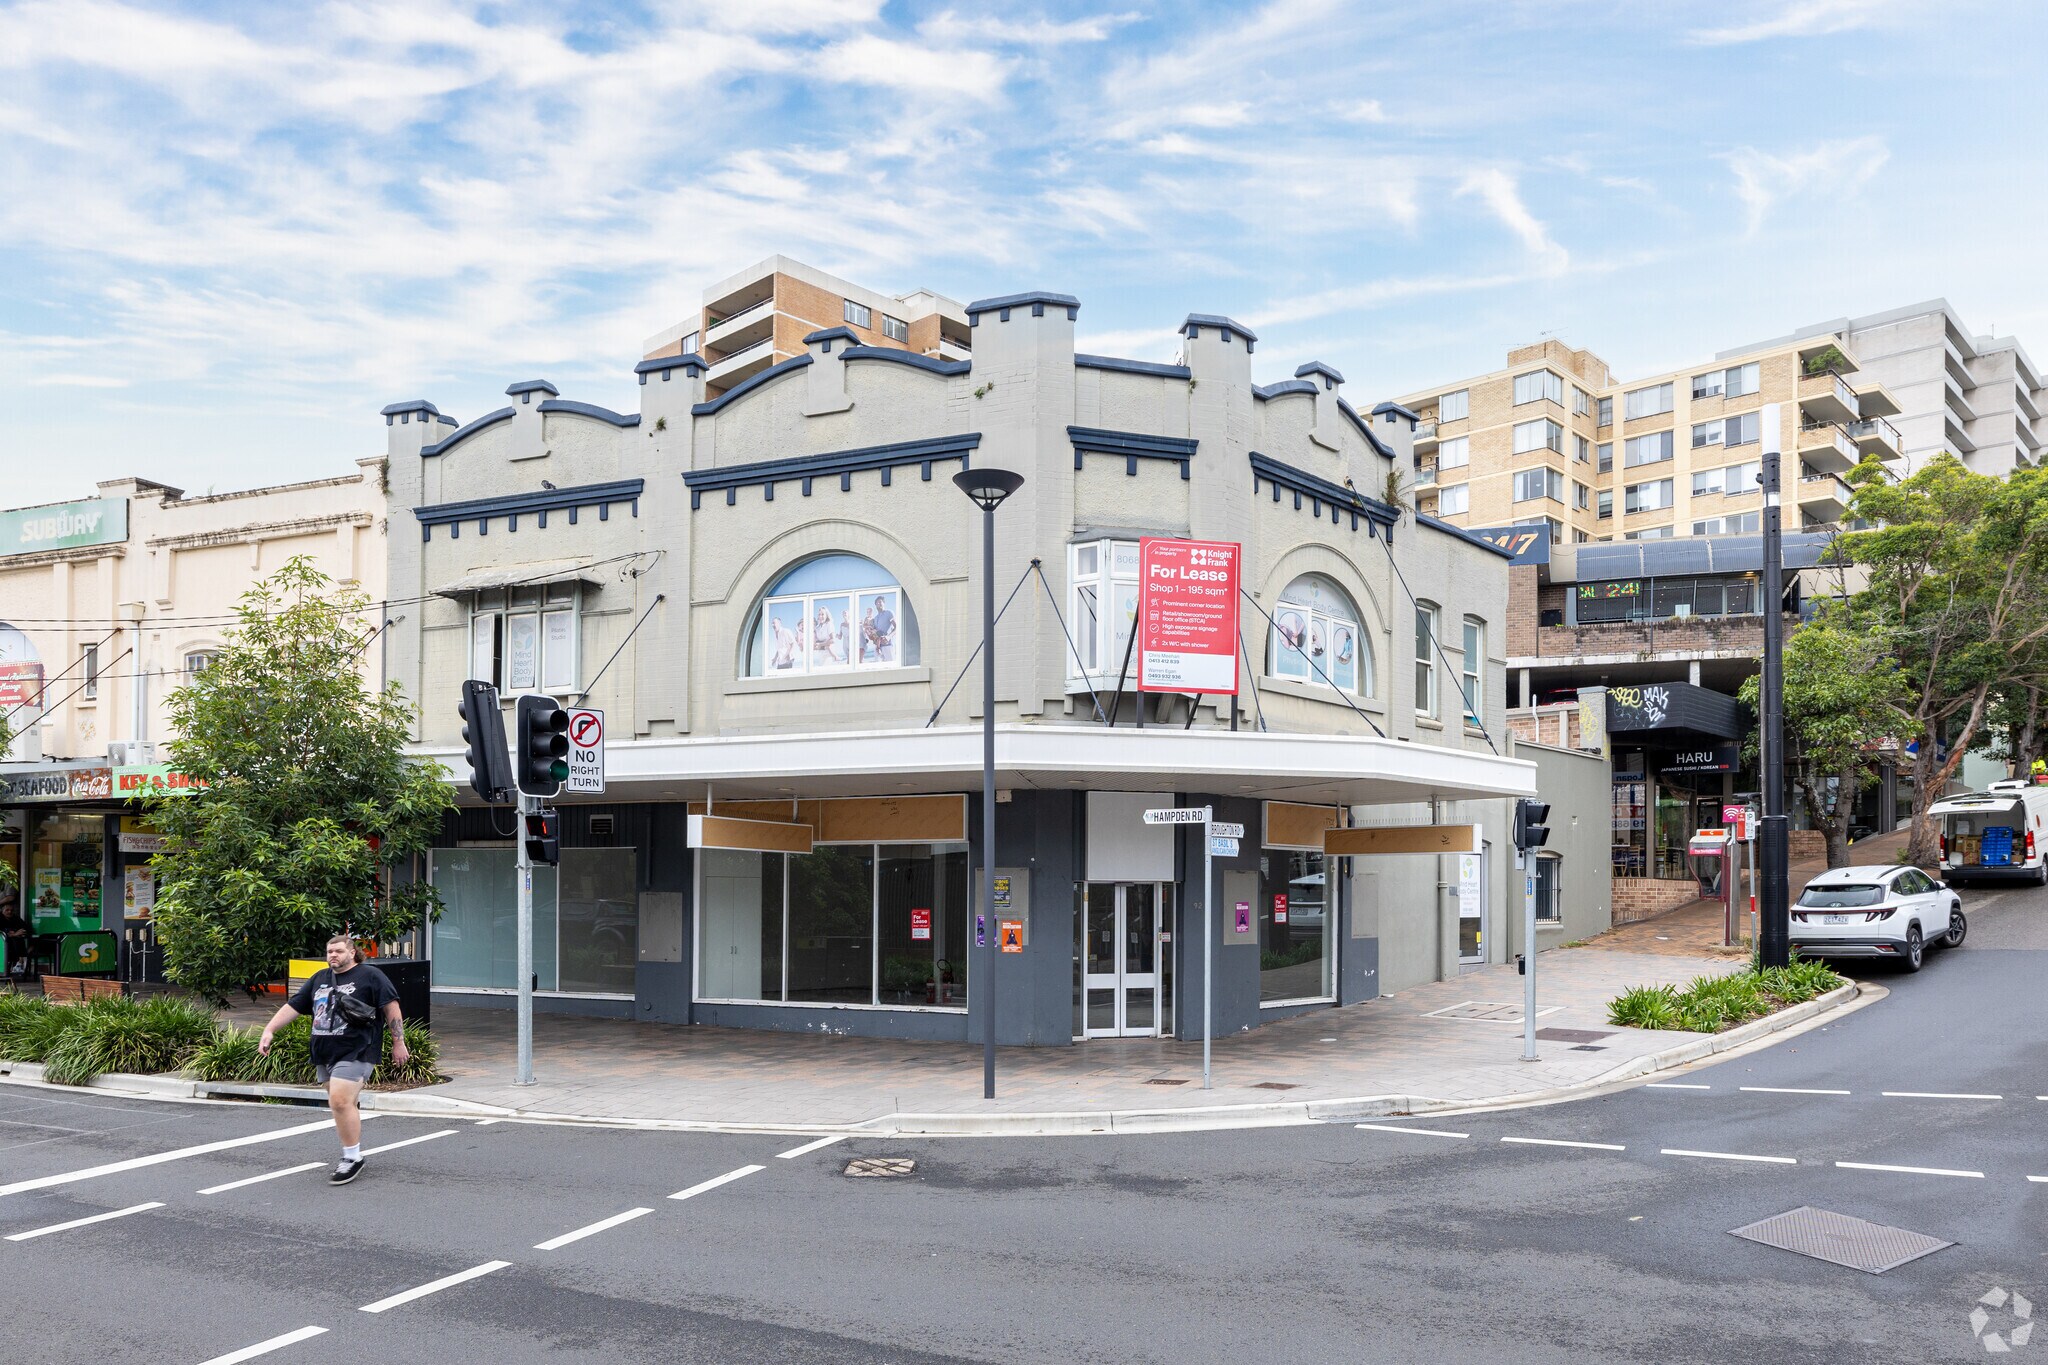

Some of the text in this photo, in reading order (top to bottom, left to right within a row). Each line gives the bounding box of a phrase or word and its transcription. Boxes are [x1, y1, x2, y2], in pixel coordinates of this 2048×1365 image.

[20, 510, 103, 543] SUBWAY
[1208, 549, 1232, 560] Knight
[1208, 558, 1228, 567] Frank
[1151, 564, 1228, 582] For Lease
[1150, 583, 1173, 594] Shop
[1175, 585, 1179, 593] 1
[1188, 586, 1203, 595] 195
[1162, 600, 1188, 608] Prominent
[1283, 592, 1344, 616] Mind Heart Body Centre
[1162, 610, 1222, 620] Retail/showroom/ground
[515, 651, 532, 659] Mind
[514, 668, 532, 677] Body
[575, 750, 596, 763] NO
[1676, 752, 1713, 764] HARU
[570, 766, 600, 776] RIGHT
[19, 776, 68, 796] SEAFOOD
[72, 776, 110, 796] Coca-Cola
[120, 774, 148, 790] KEY
[572, 778, 600, 788] TURN
[1154, 811, 1190, 822] HAMPDEN
[1192, 810, 1203, 821] RD
[1211, 824, 1234, 835] BROUGHTON
[1212, 838, 1218, 847] ST
[1193, 902, 1203, 910] 92
